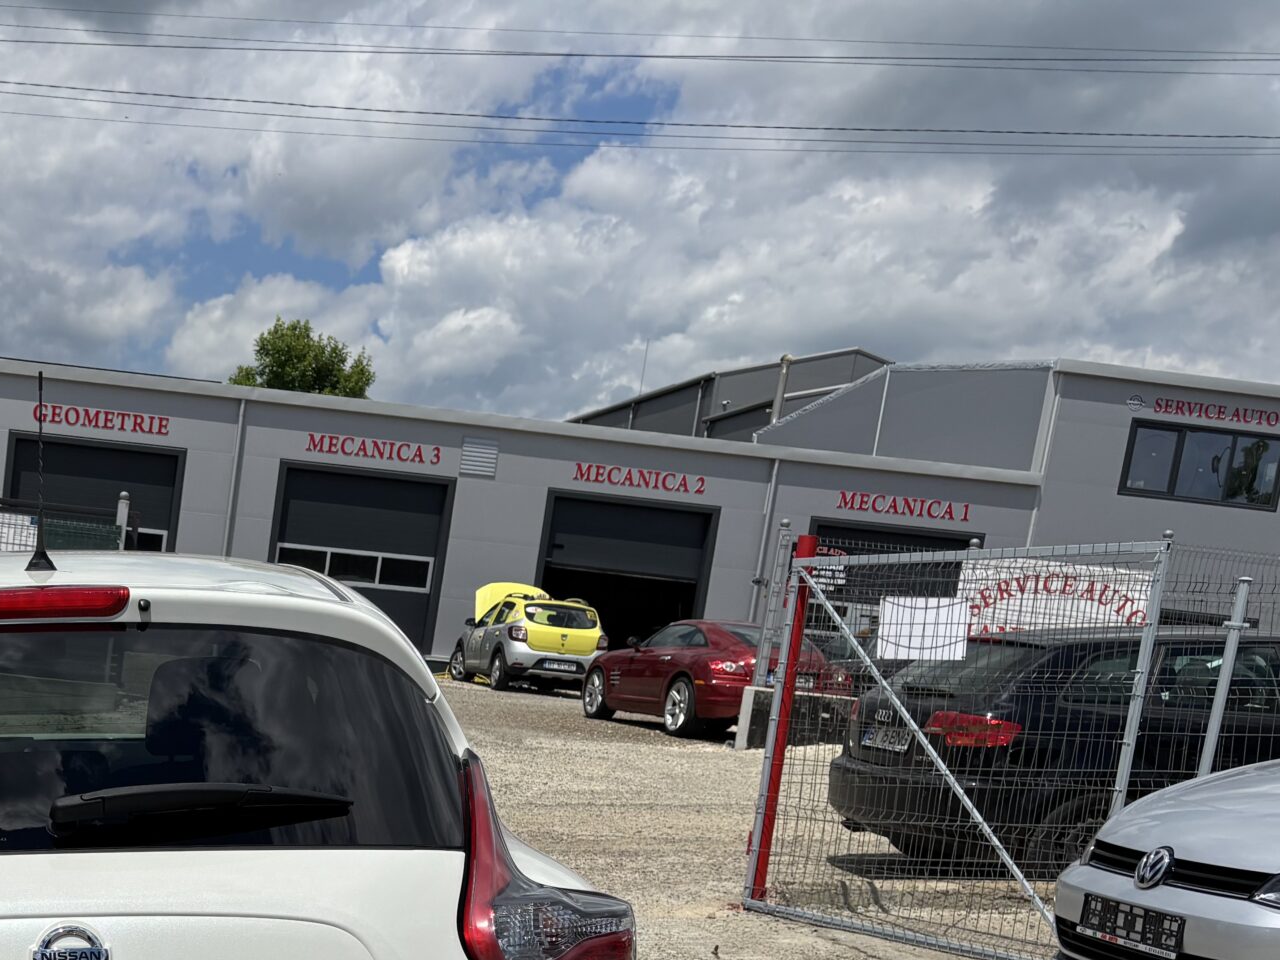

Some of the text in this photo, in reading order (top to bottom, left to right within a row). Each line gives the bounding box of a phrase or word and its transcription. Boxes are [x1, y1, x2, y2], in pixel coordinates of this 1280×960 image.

[33, 404, 170, 436] GEOMETRIE
[1153, 398, 1279, 427] SERVICE AUTO
[305, 433, 441, 465] MECANICA 3
[573, 463, 706, 495] MECANICA 2
[836, 491, 970, 521] MECANICA 1
[969, 573, 1077, 617] SERVICE
